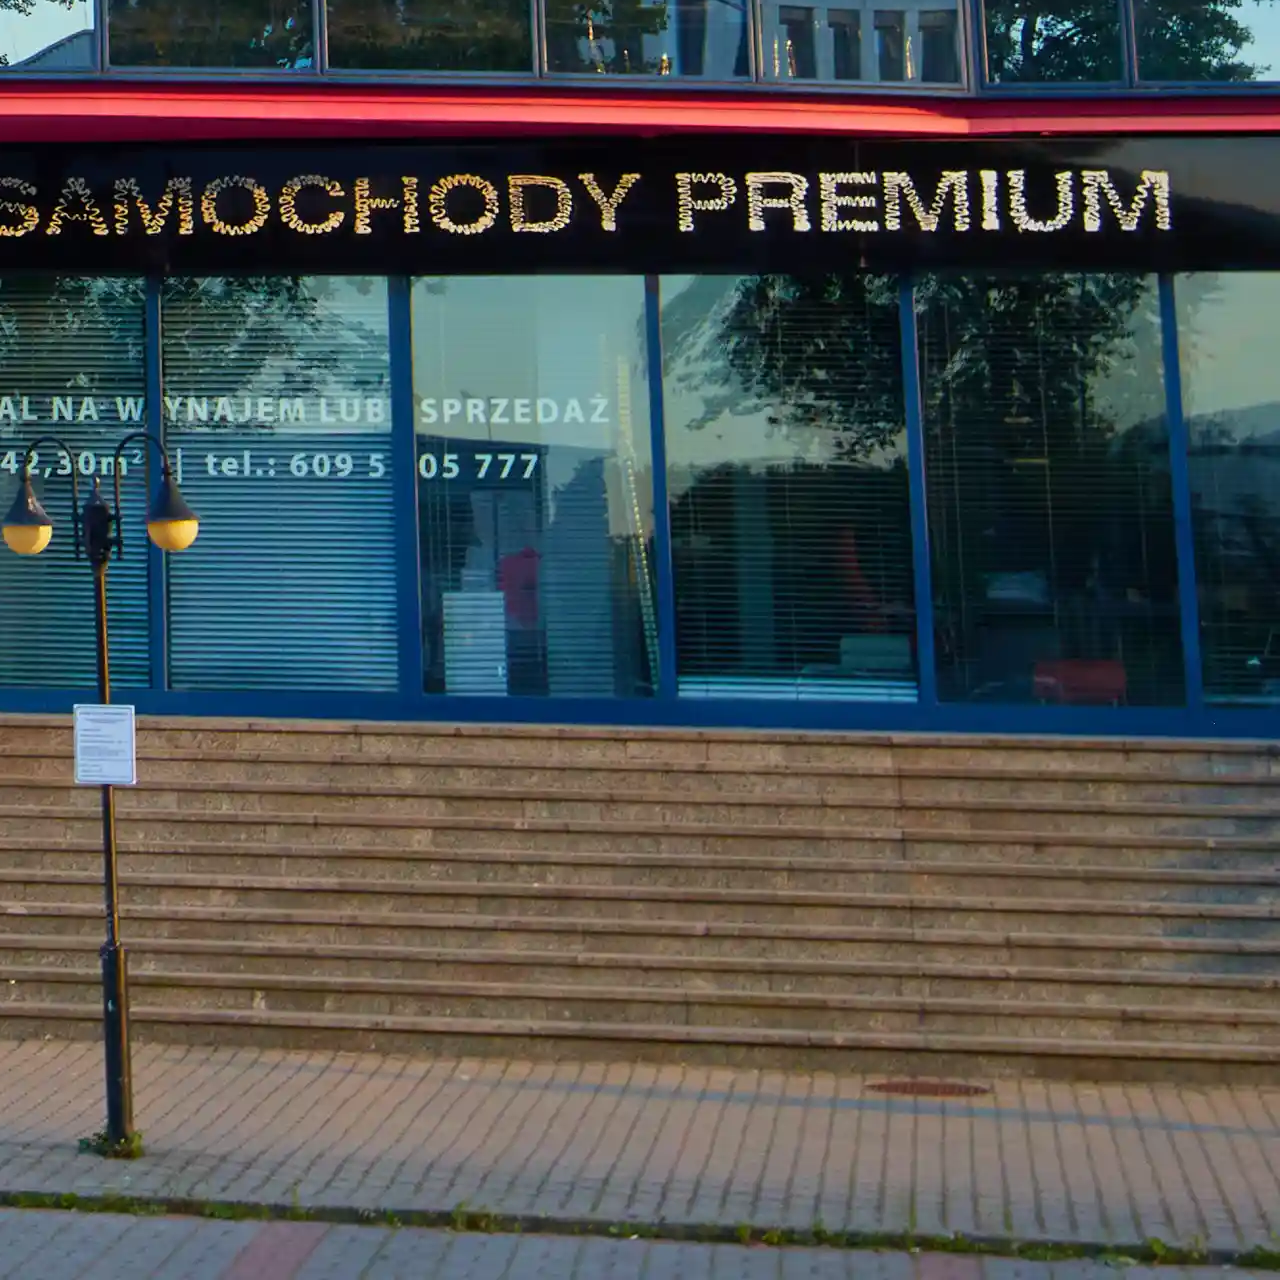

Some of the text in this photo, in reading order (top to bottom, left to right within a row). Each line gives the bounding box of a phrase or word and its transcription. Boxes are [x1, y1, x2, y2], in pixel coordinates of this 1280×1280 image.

[675, 170, 1171, 235] PREMIUM
[51, 396, 100, 422] NA
[319, 397, 385, 424] LUB
[419, 393, 611, 425] SPRZEDAŻ
[205, 450, 276, 477] tel.:
[290, 452, 354, 478] 609
[475, 454, 539, 480] 777
